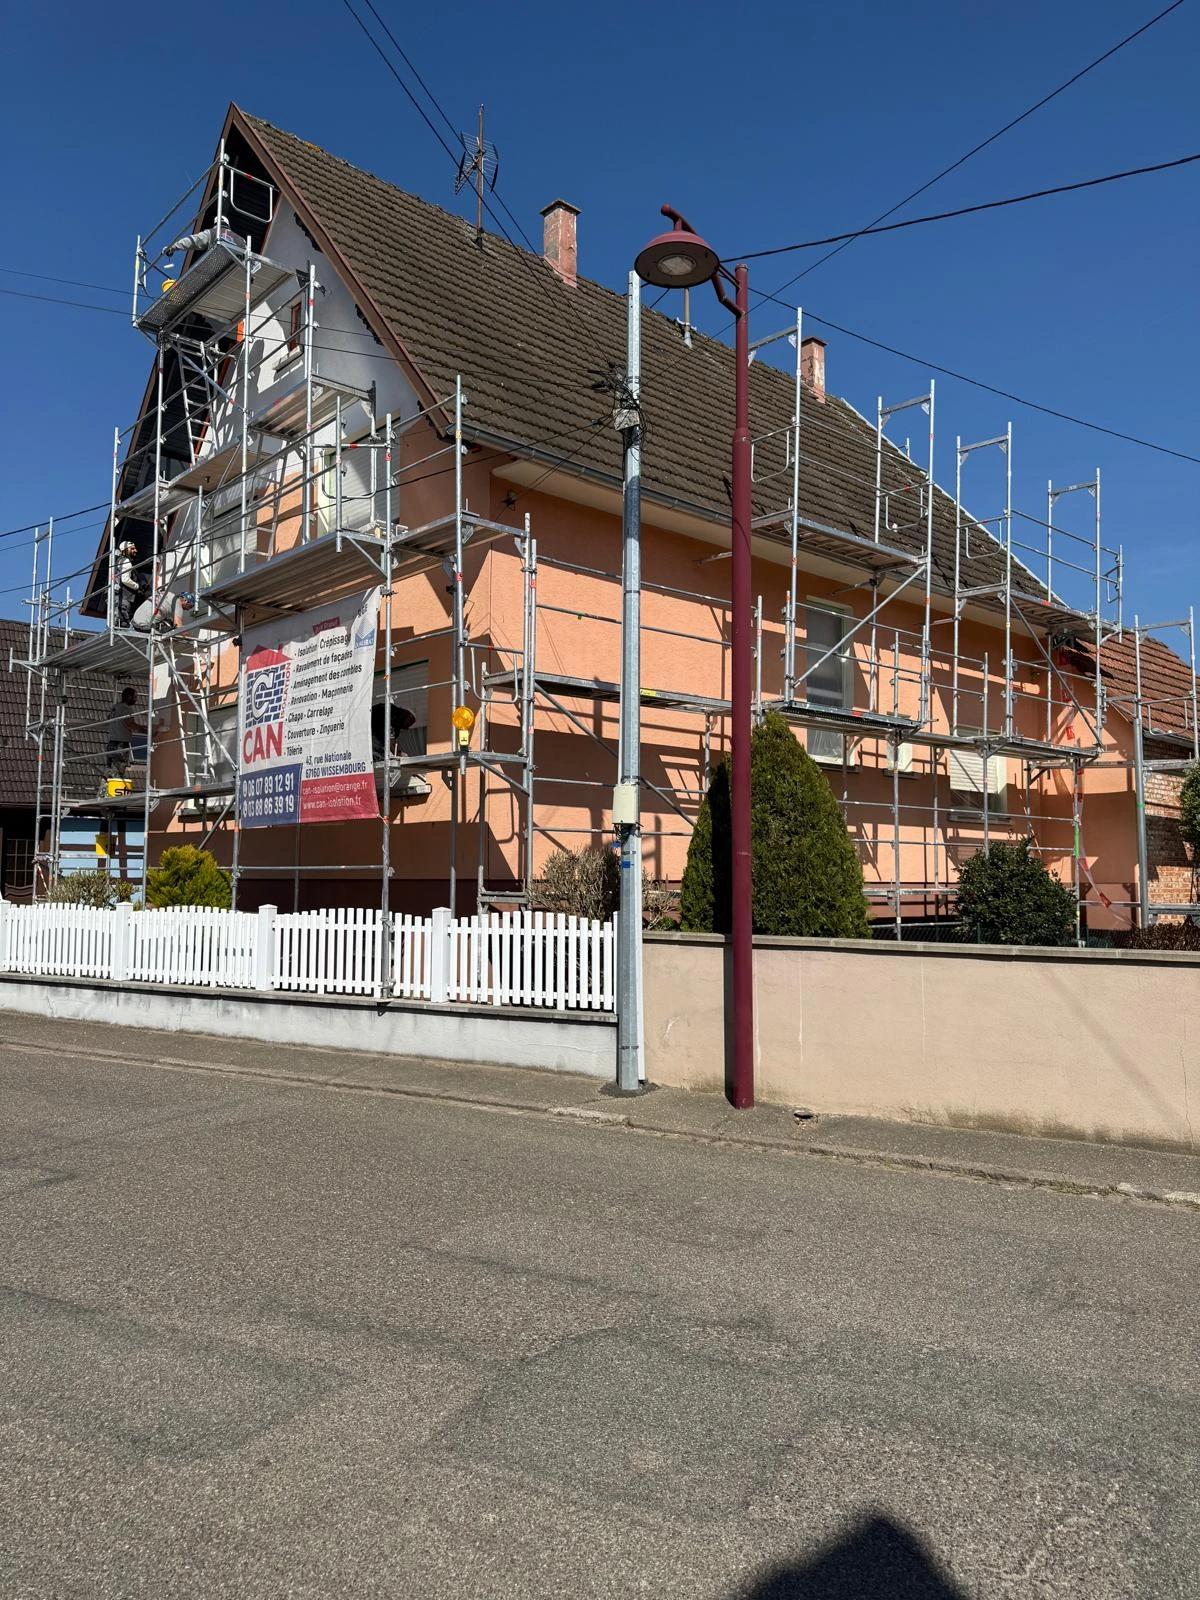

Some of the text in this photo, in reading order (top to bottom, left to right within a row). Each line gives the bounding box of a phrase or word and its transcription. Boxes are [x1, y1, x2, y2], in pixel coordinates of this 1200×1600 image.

[297, 644, 317, 657] Isolation
[296, 650, 352, 673] Ravalement de façades
[329, 669, 340, 680] des
[340, 664, 362, 678] combles
[280, 662, 291, 719] ISOLATION
[288, 706, 333, 723] Chape Carrelage
[288, 720, 344, 740] Couverture Zinguerie
[243, 722, 283, 764] CAN
[287, 745, 303, 757] Tôlerie
[314, 755, 323, 764] rue
[324, 750, 352, 763] Nationale
[306, 762, 366, 778] 67160 WISSEMBOURG
[248, 772, 294, 796] 06 07 89 12 91
[303, 780, 368, 795] can-isolation@orange.fr
[248, 801, 254, 816] 03
[264, 797, 273, 814] 86
[274, 796, 284, 813] 39
[285, 794, 294, 812] 19
[303, 796, 361, 810] www.can-isolation.fr
